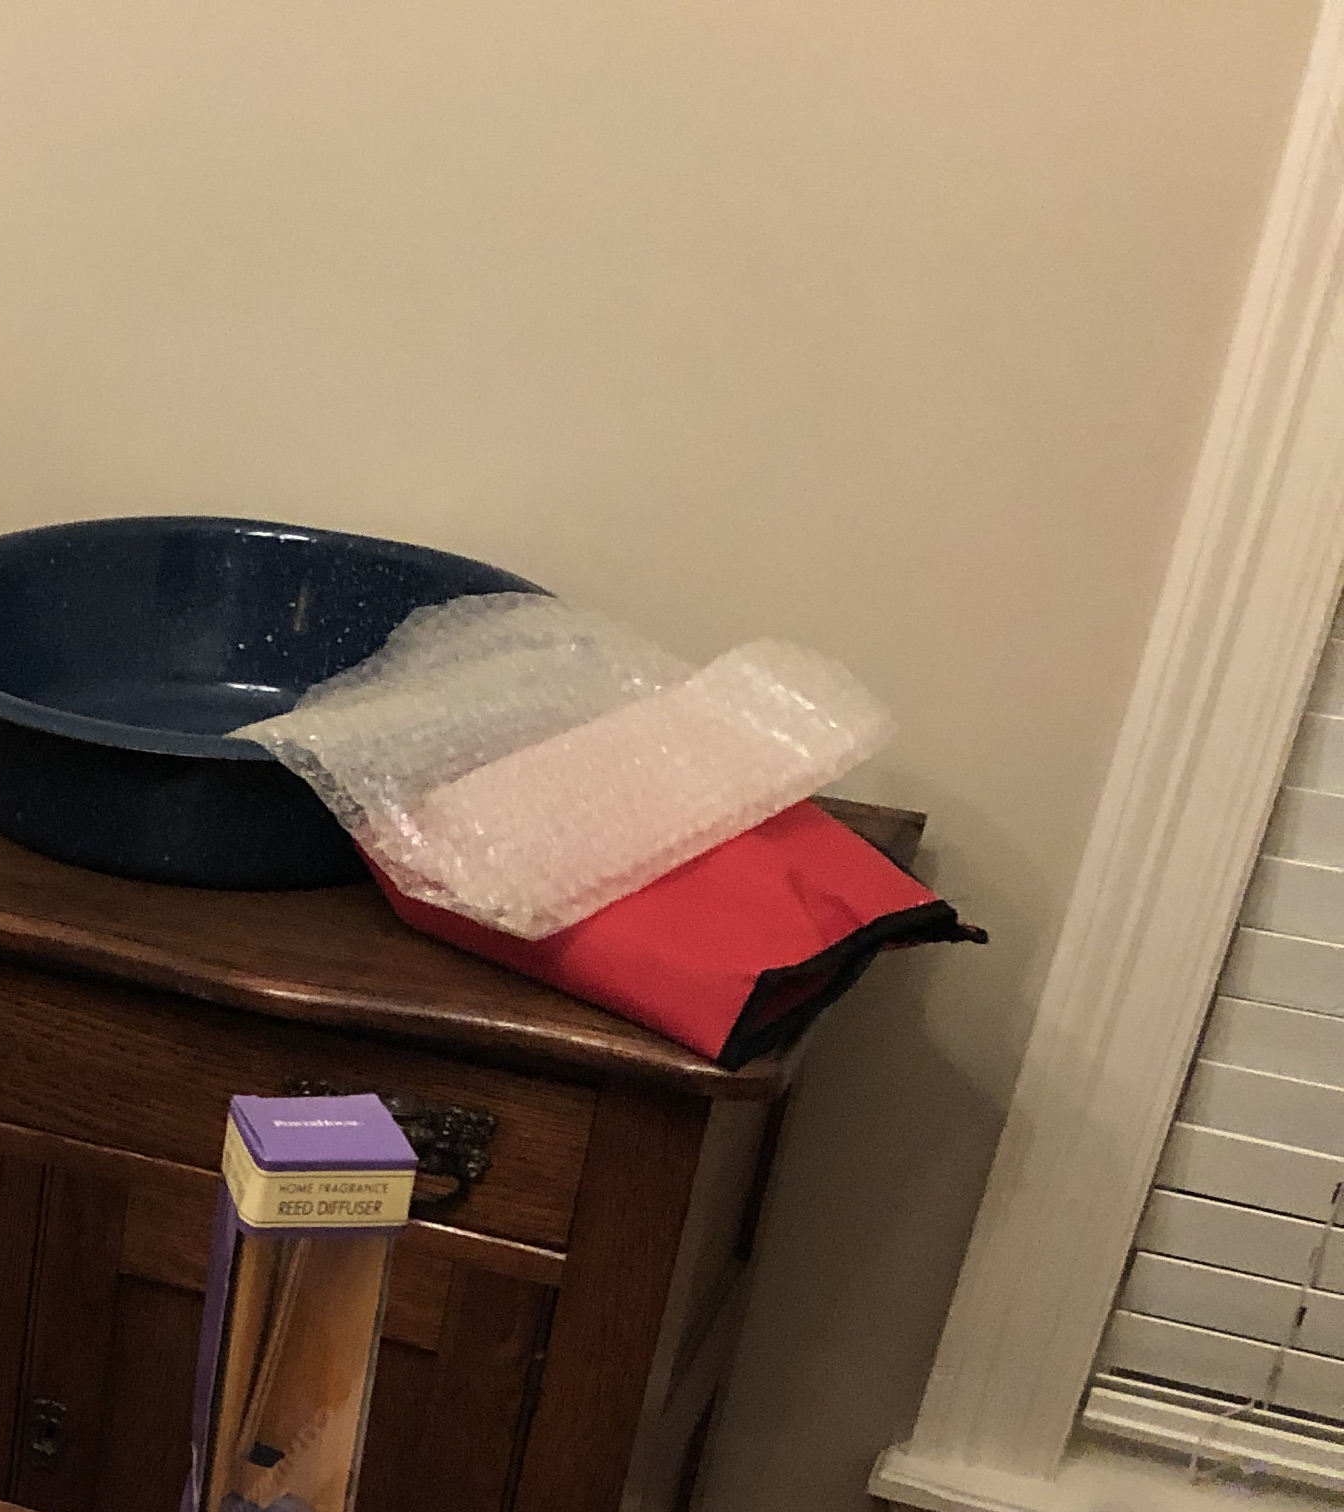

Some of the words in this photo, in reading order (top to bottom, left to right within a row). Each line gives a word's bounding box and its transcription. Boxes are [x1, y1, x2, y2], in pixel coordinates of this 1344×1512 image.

[279, 1183, 313, 1194] HOME
[318, 1183, 390, 1194] FRAGRANCE
[277, 1201, 313, 1215] REED
[318, 1200, 383, 1215] DIFFUSER
